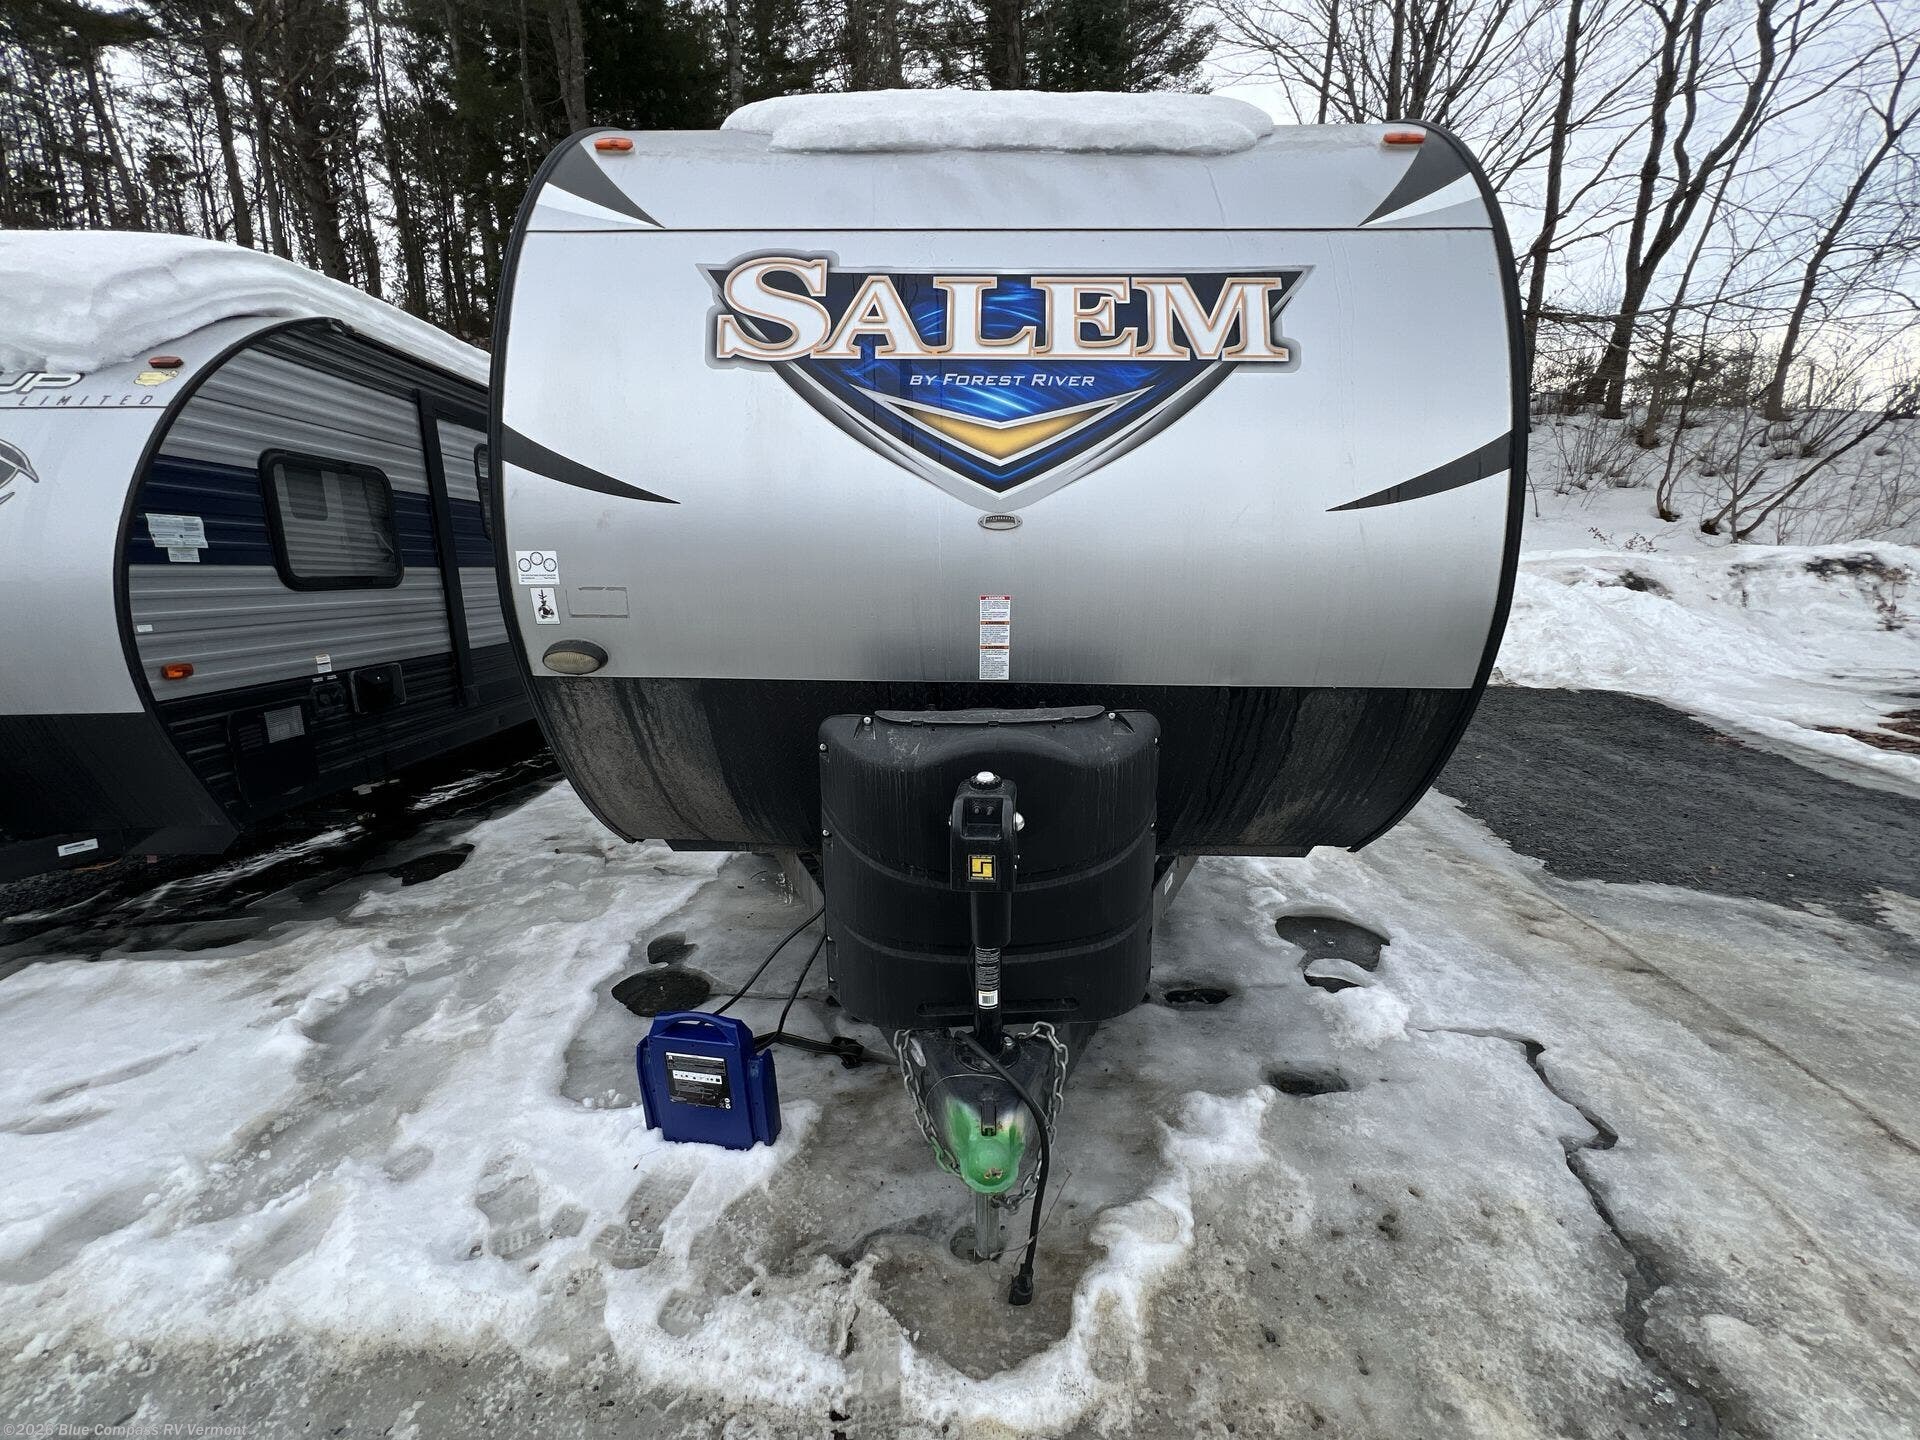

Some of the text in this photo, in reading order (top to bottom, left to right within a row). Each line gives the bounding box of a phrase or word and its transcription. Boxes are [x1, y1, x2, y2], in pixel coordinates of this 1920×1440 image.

[716, 256, 1289, 362] SALEM
[942, 373, 1025, 386] FOREST
[1031, 373, 1095, 387] RIVER
[18, 395, 154, 406] LIMITED
